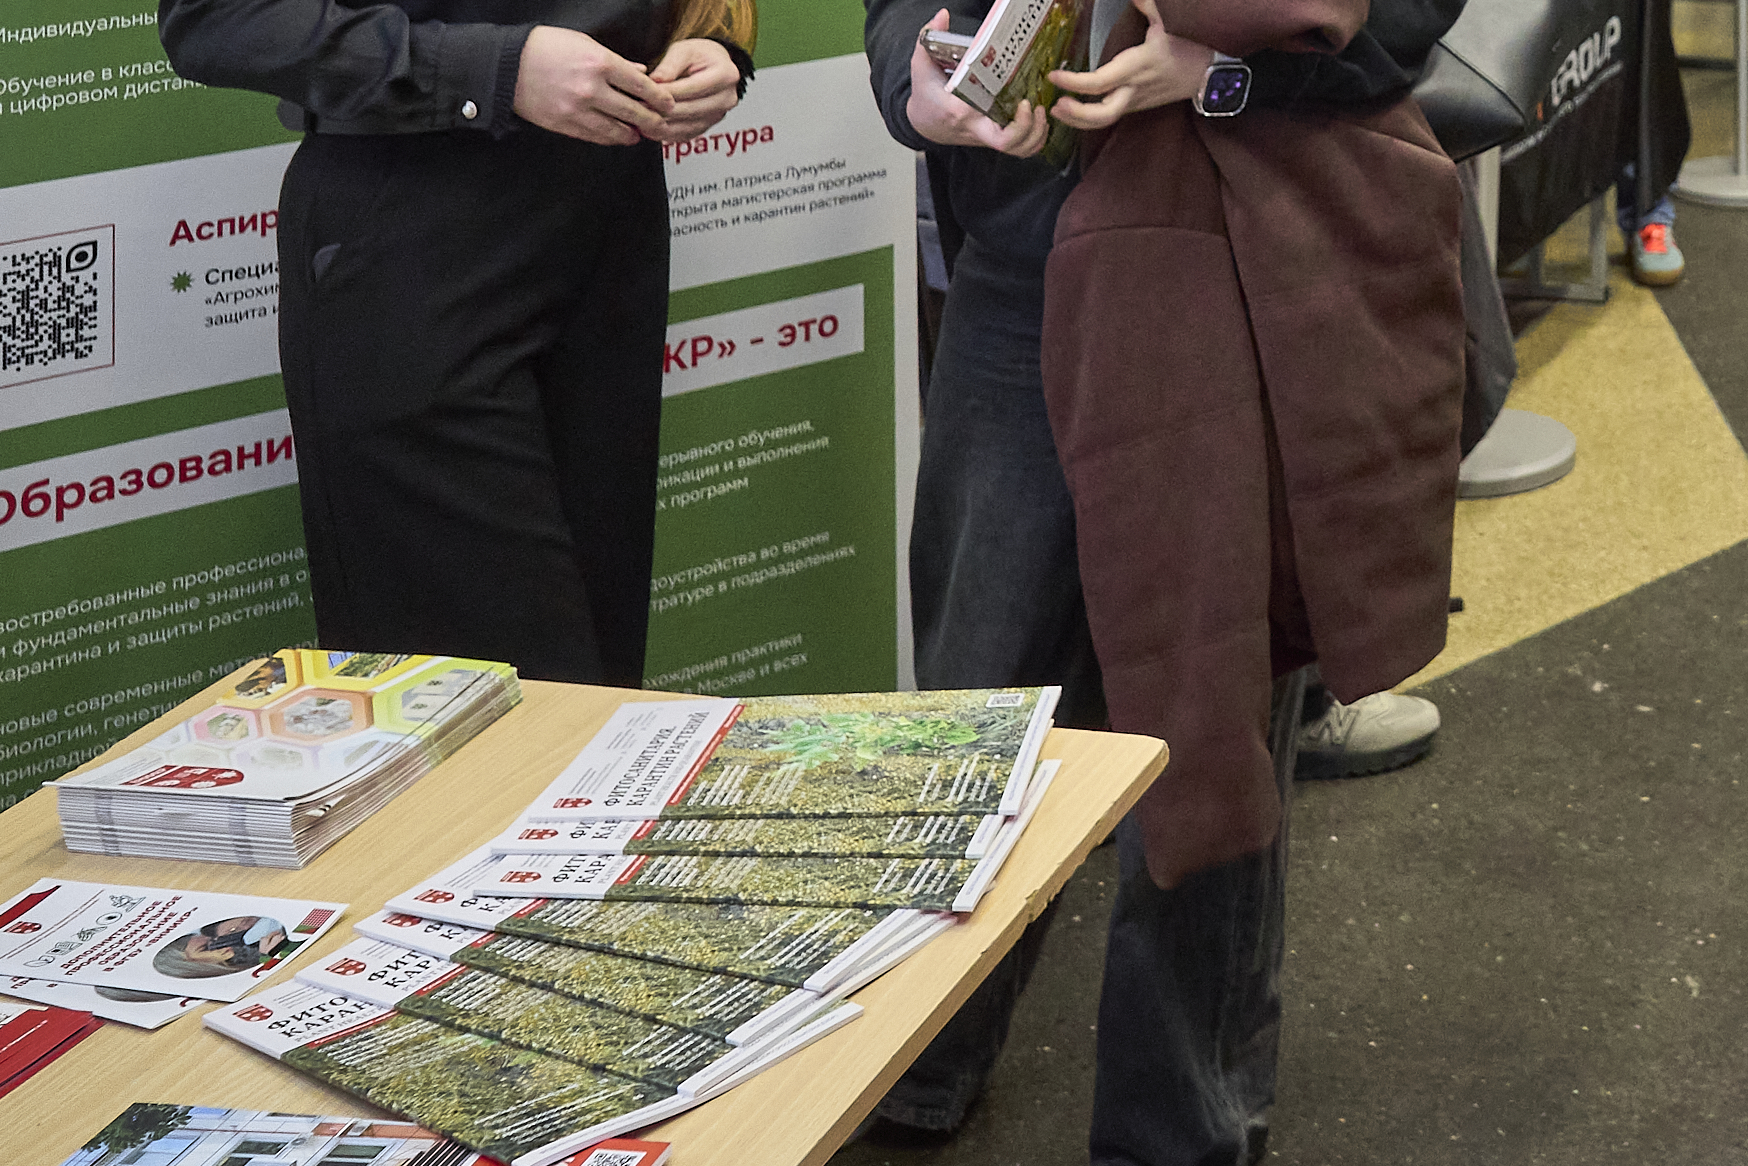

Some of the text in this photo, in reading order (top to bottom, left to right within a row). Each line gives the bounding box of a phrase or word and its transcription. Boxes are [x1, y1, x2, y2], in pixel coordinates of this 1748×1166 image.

[102, 67, 113, 82] в
[9, 84, 119, 116] цифровом
[721, 182, 815, 208] магистерская
[818, 166, 888, 193] программа
[724, 169, 782, 191] Патриса
[785, 157, 847, 181] Лумумбы
[732, 213, 740, 226] и
[744, 201, 806, 224] карантин
[205, 305, 268, 328] защита
[777, 314, 840, 348] это
[671, 476, 749, 509] программ
[760, 544, 779, 561] во
[12, 593, 201, 658] фундаментальные
[205, 576, 274, 604] знания
[279, 573, 290, 589] в
[108, 639, 120, 655] и
[126, 619, 203, 650] защиты
[64, 668, 203, 718] современные
